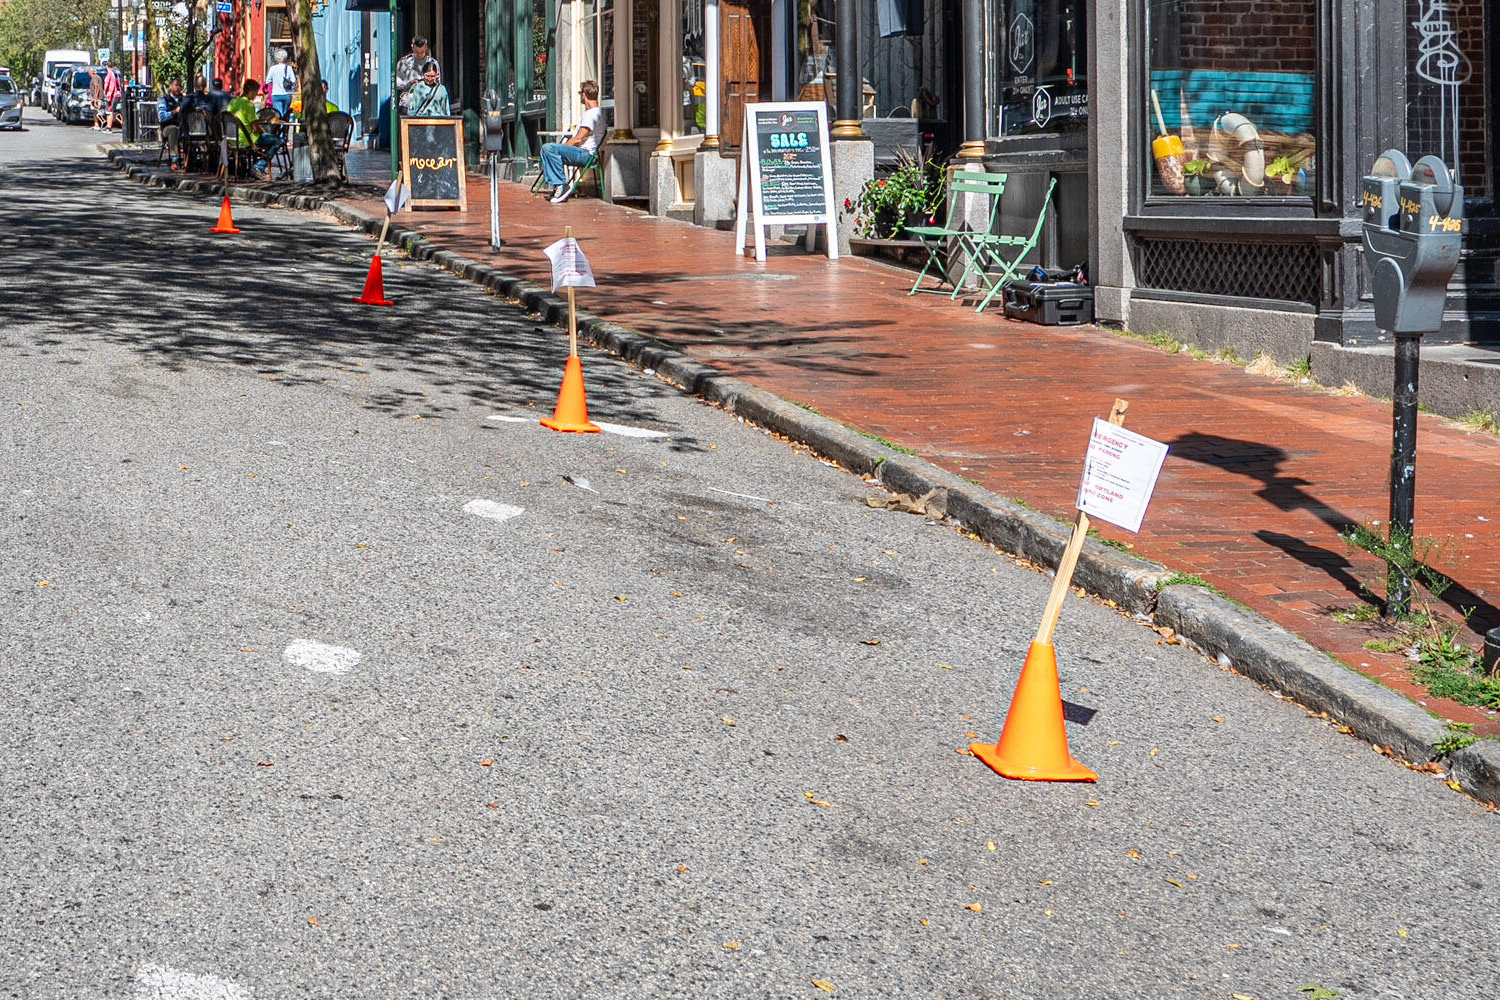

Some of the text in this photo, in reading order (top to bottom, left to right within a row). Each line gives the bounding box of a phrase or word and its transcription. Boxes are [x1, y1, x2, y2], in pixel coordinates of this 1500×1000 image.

[1014, 24, 1029, 60] Jar
[1036, 94, 1048, 119] Jar
[1054, 96, 1070, 106] ADULT
[1071, 95, 1080, 104] USE
[1079, 106, 1088, 116] ONL
[770, 132, 808, 148] SALE
